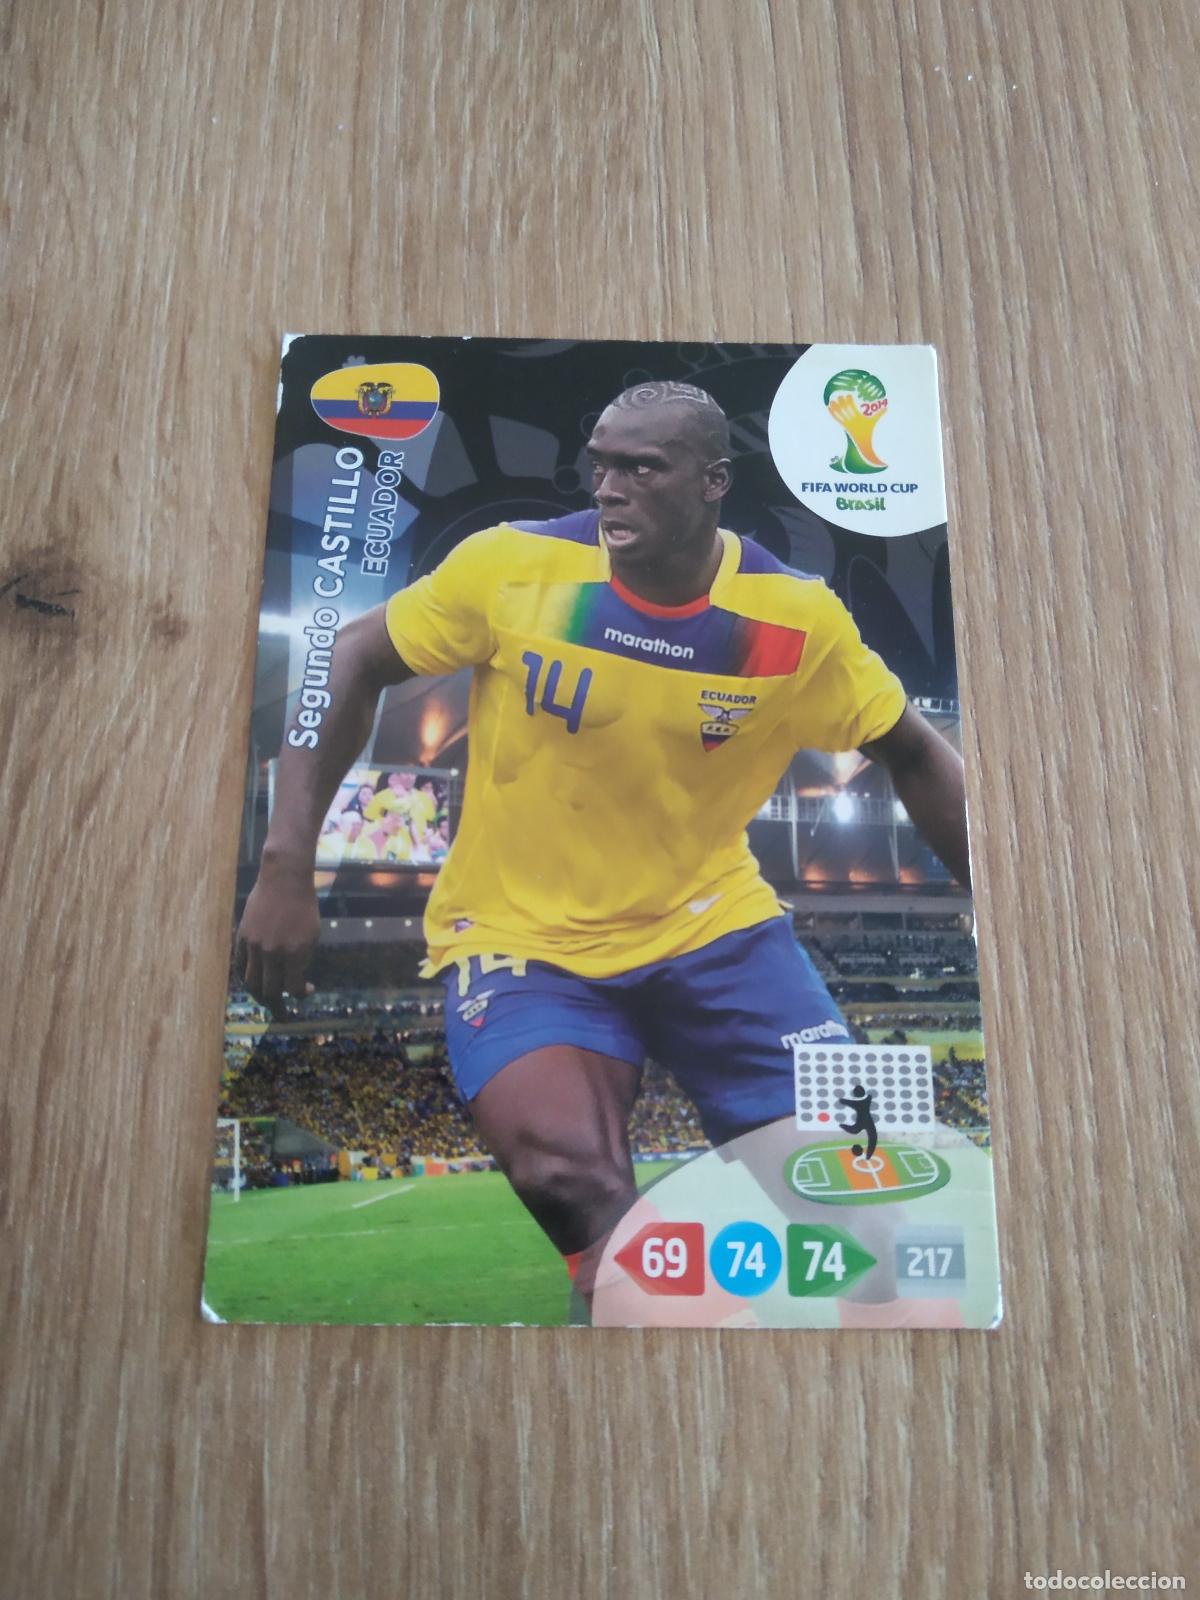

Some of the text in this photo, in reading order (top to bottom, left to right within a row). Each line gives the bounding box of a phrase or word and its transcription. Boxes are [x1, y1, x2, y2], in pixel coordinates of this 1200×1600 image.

[861, 399, 888, 416] 2014
[801, 482, 918, 493] FIFA WORLD CUP
[836, 497, 886, 511] Brasil
[361, 450, 404, 576] ECUADOR
[288, 446, 365, 750] Segundo CASTILLO
[604, 627, 694, 660] marathon
[522, 651, 593, 735] 14
[701, 690, 757, 704] ECUADOR
[642, 1237, 688, 1278] 69
[727, 1241, 766, 1278] 74
[803, 1241, 846, 1281] 74
[906, 1247, 953, 1278] 217
